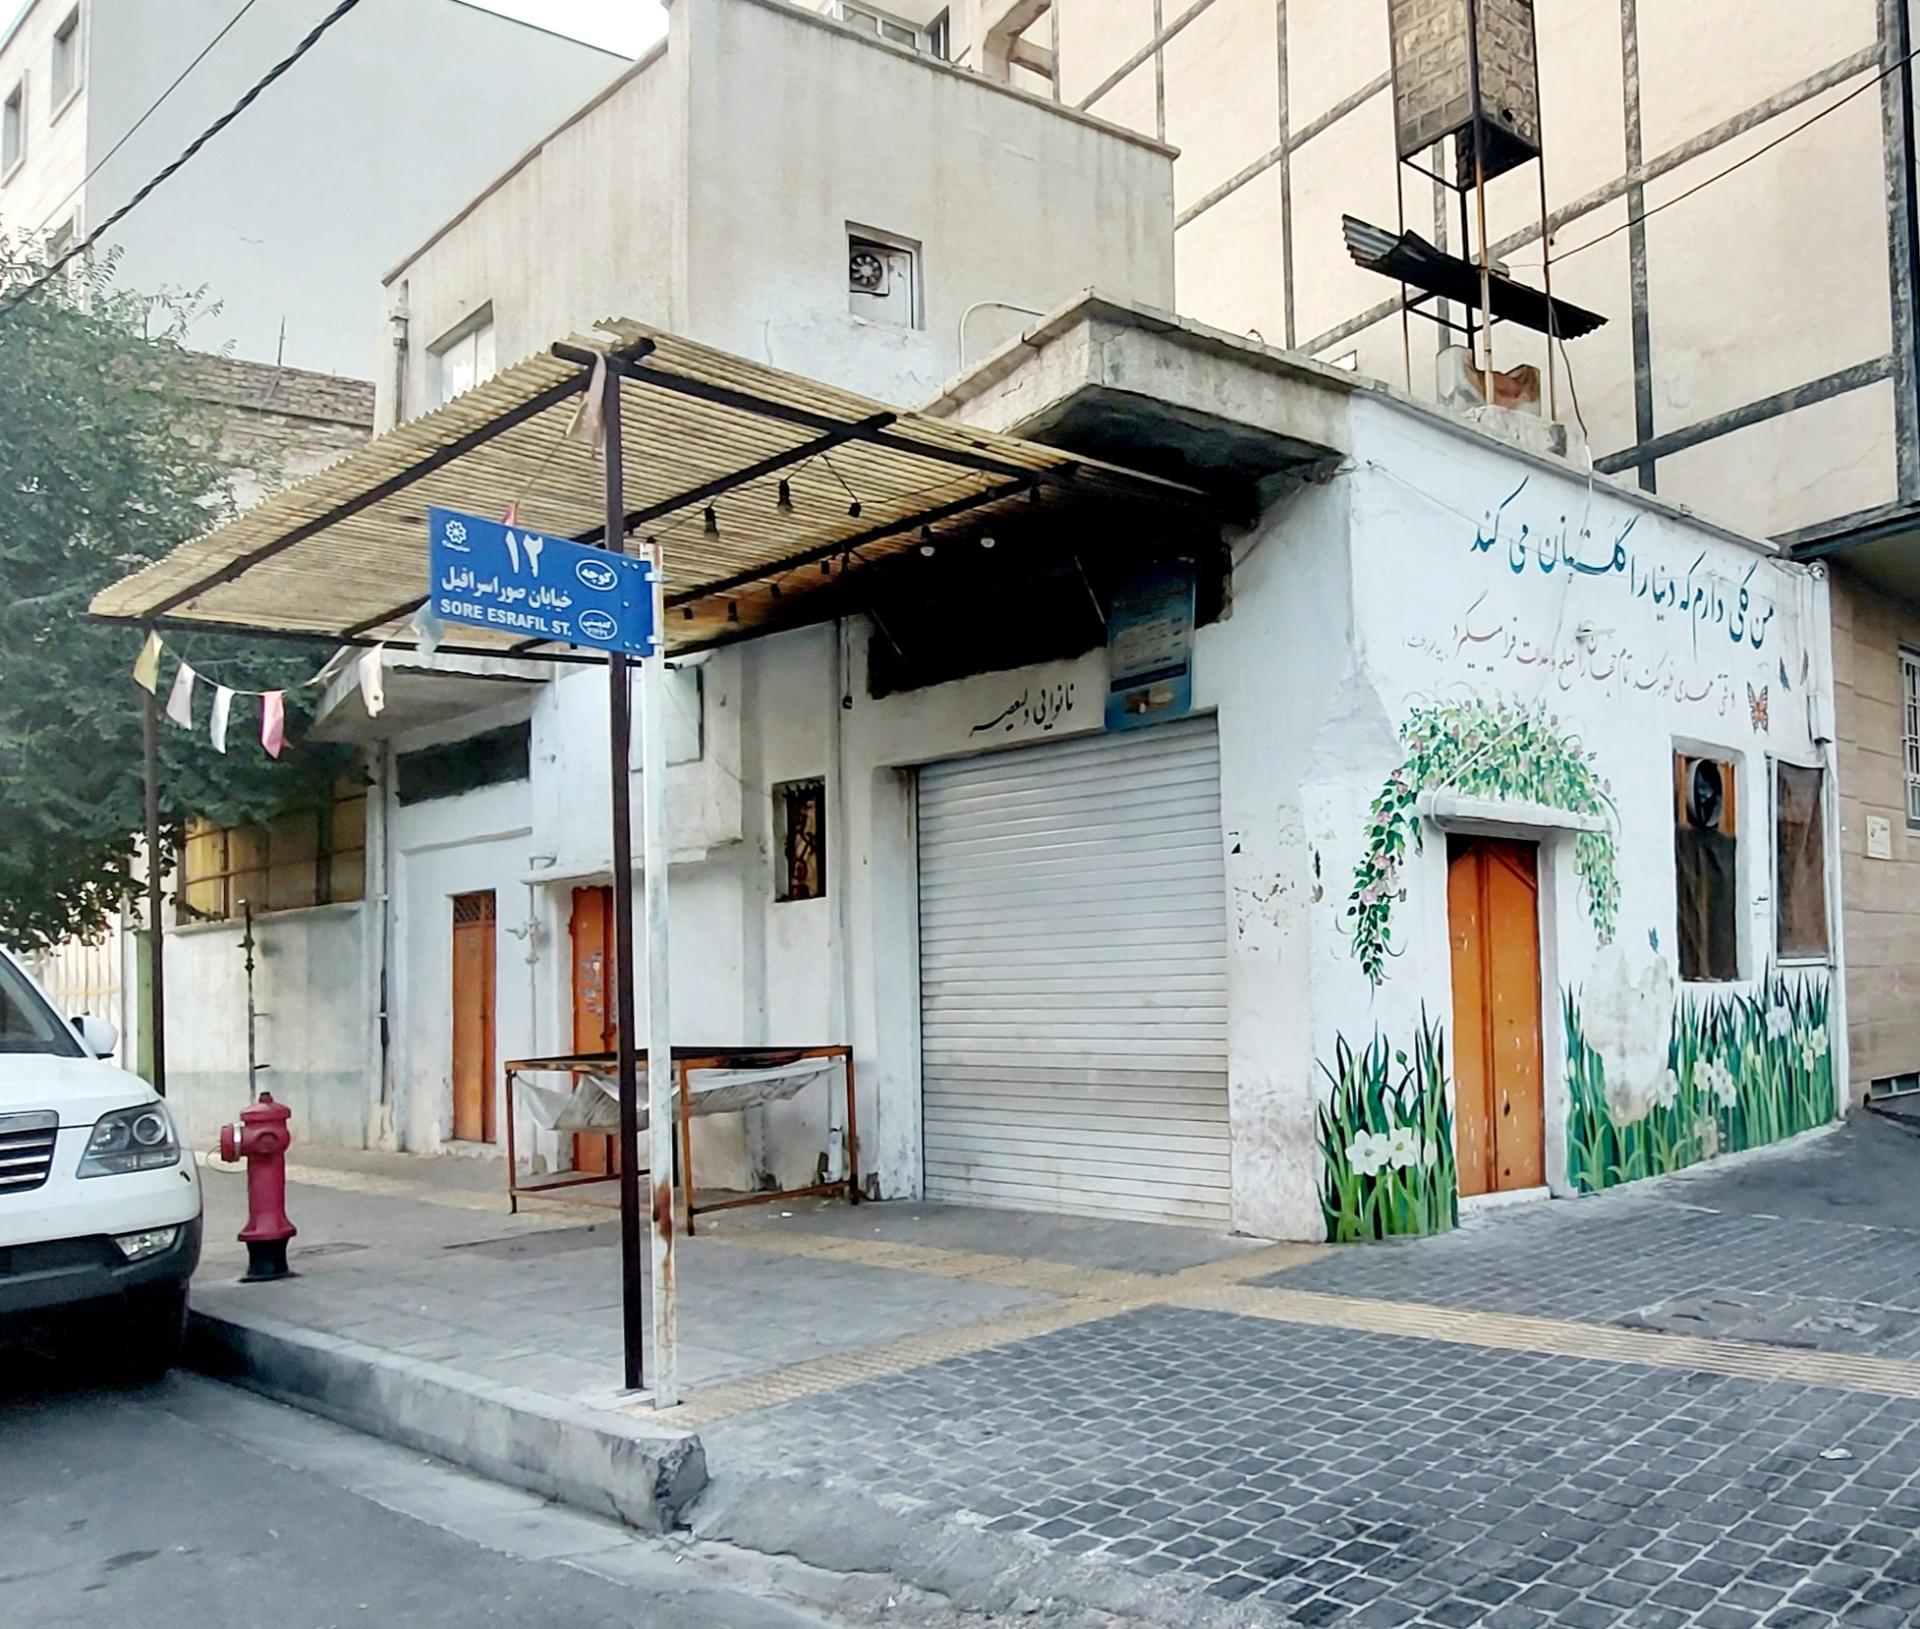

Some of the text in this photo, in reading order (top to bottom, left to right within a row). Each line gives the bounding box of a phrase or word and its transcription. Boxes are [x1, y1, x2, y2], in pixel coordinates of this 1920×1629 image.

[504, 529, 544, 579] ۱۲
[1469, 474, 1774, 664] من گلی دارم که دنیا را گلستان می کند
[527, 584, 574, 612] خیابان
[581, 568, 612, 586] کوچه
[440, 598, 483, 620] SORE
[487, 608, 549, 632] ESRAFIL
[551, 621, 572, 637] ST.
[1033, 683, 1075, 731] نانوایی
